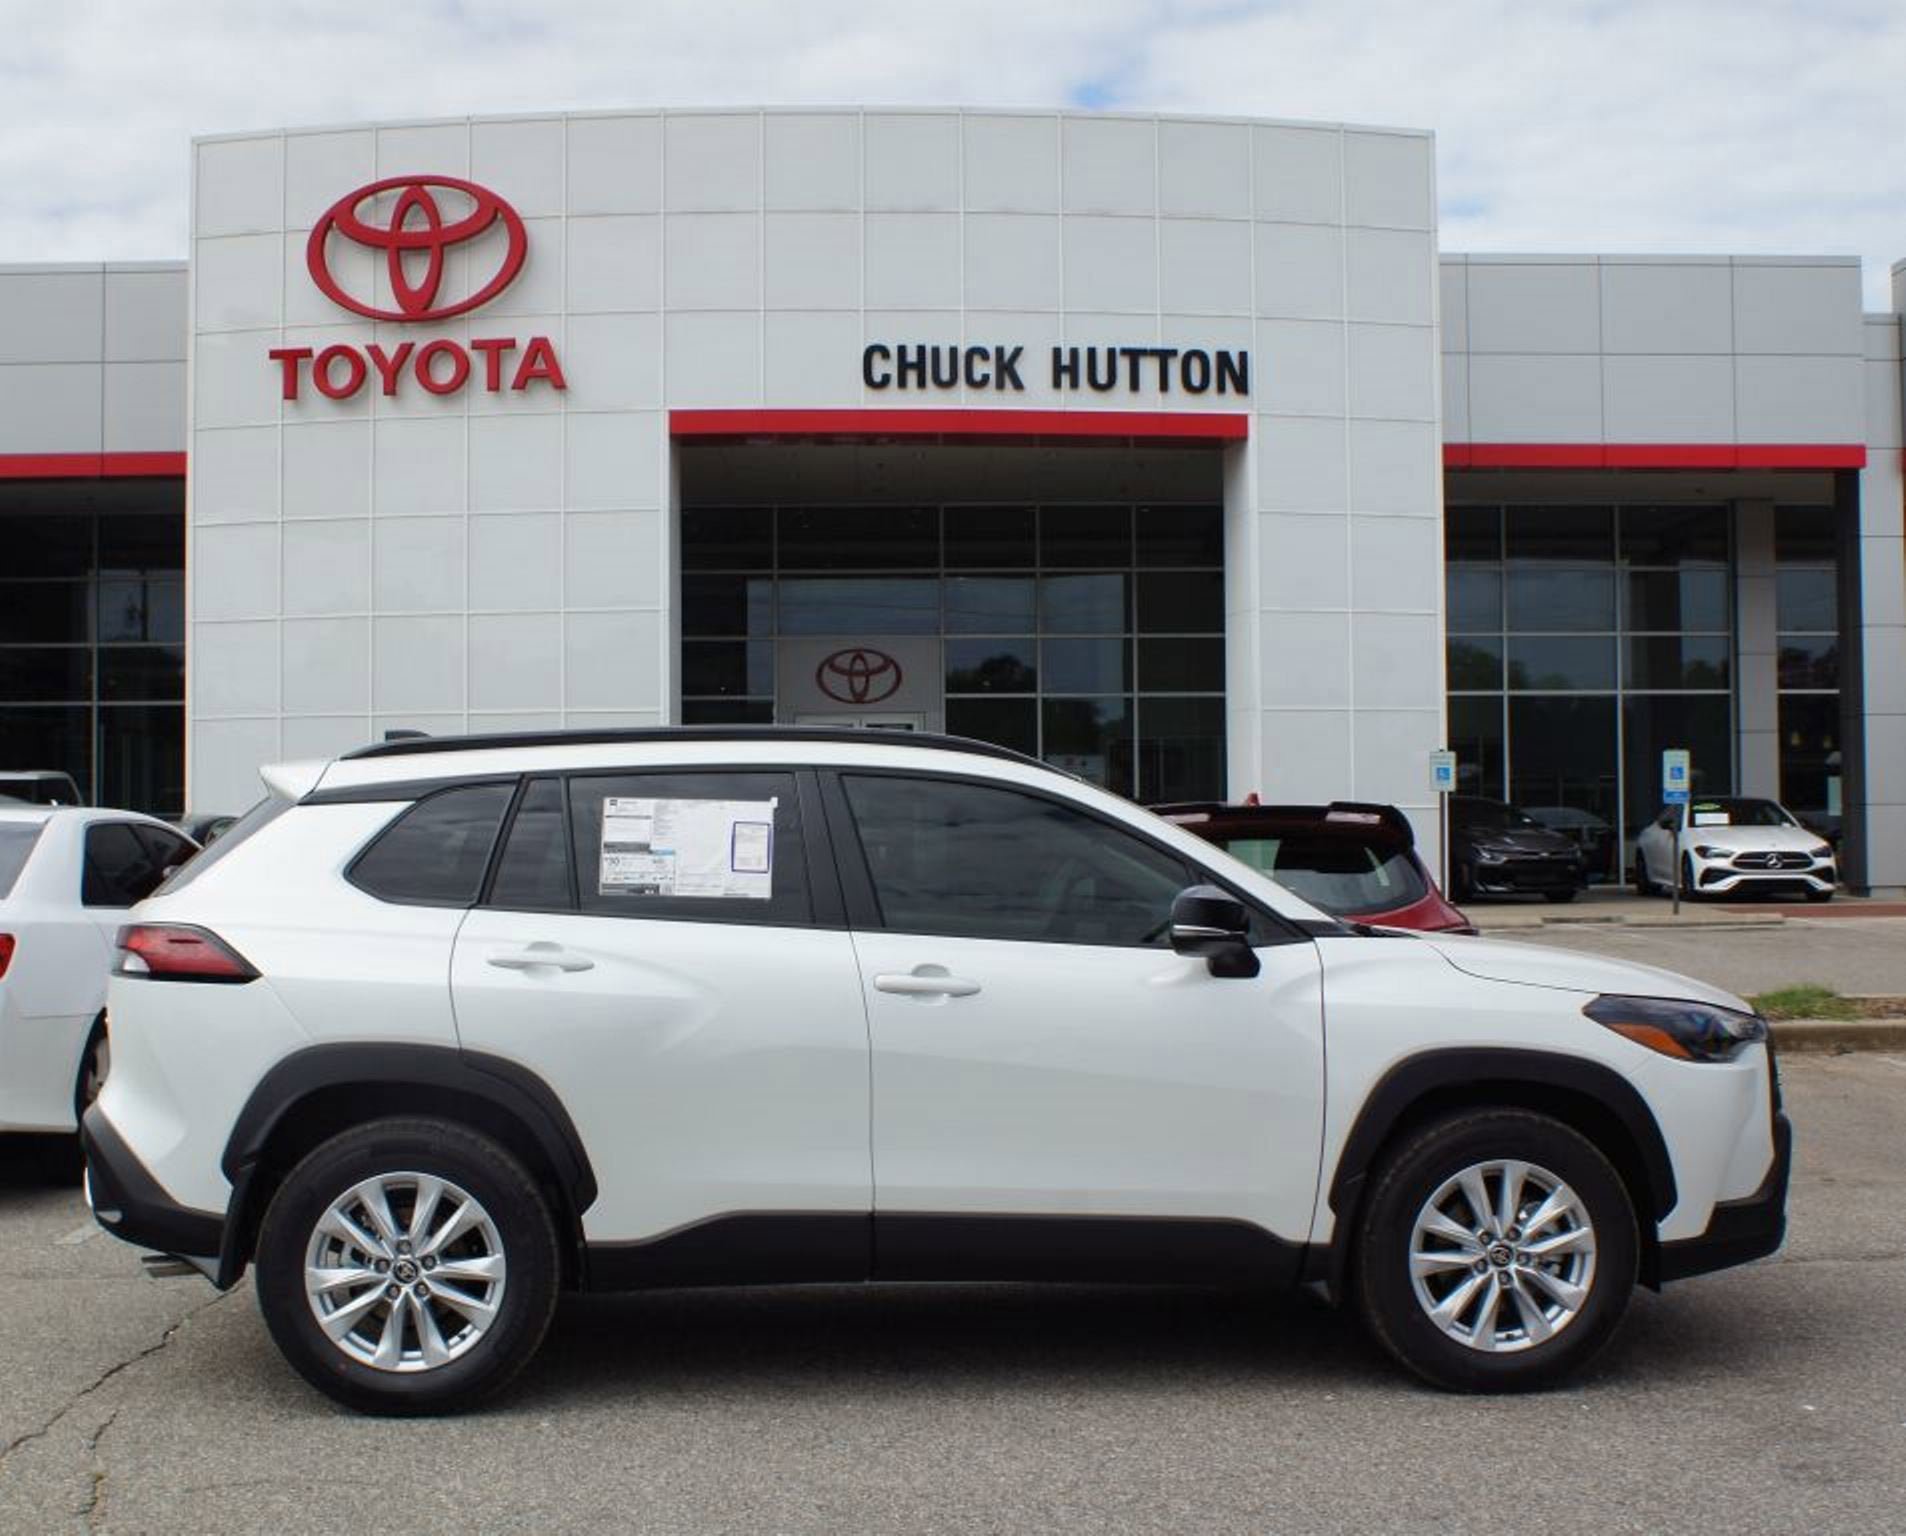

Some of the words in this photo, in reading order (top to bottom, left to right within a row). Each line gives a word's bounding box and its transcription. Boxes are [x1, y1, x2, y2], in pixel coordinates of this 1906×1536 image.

[269, 337, 567, 400] TOYOTA
[863, 344, 1025, 391] CHUCK
[1052, 347, 1249, 395] HUTTON
